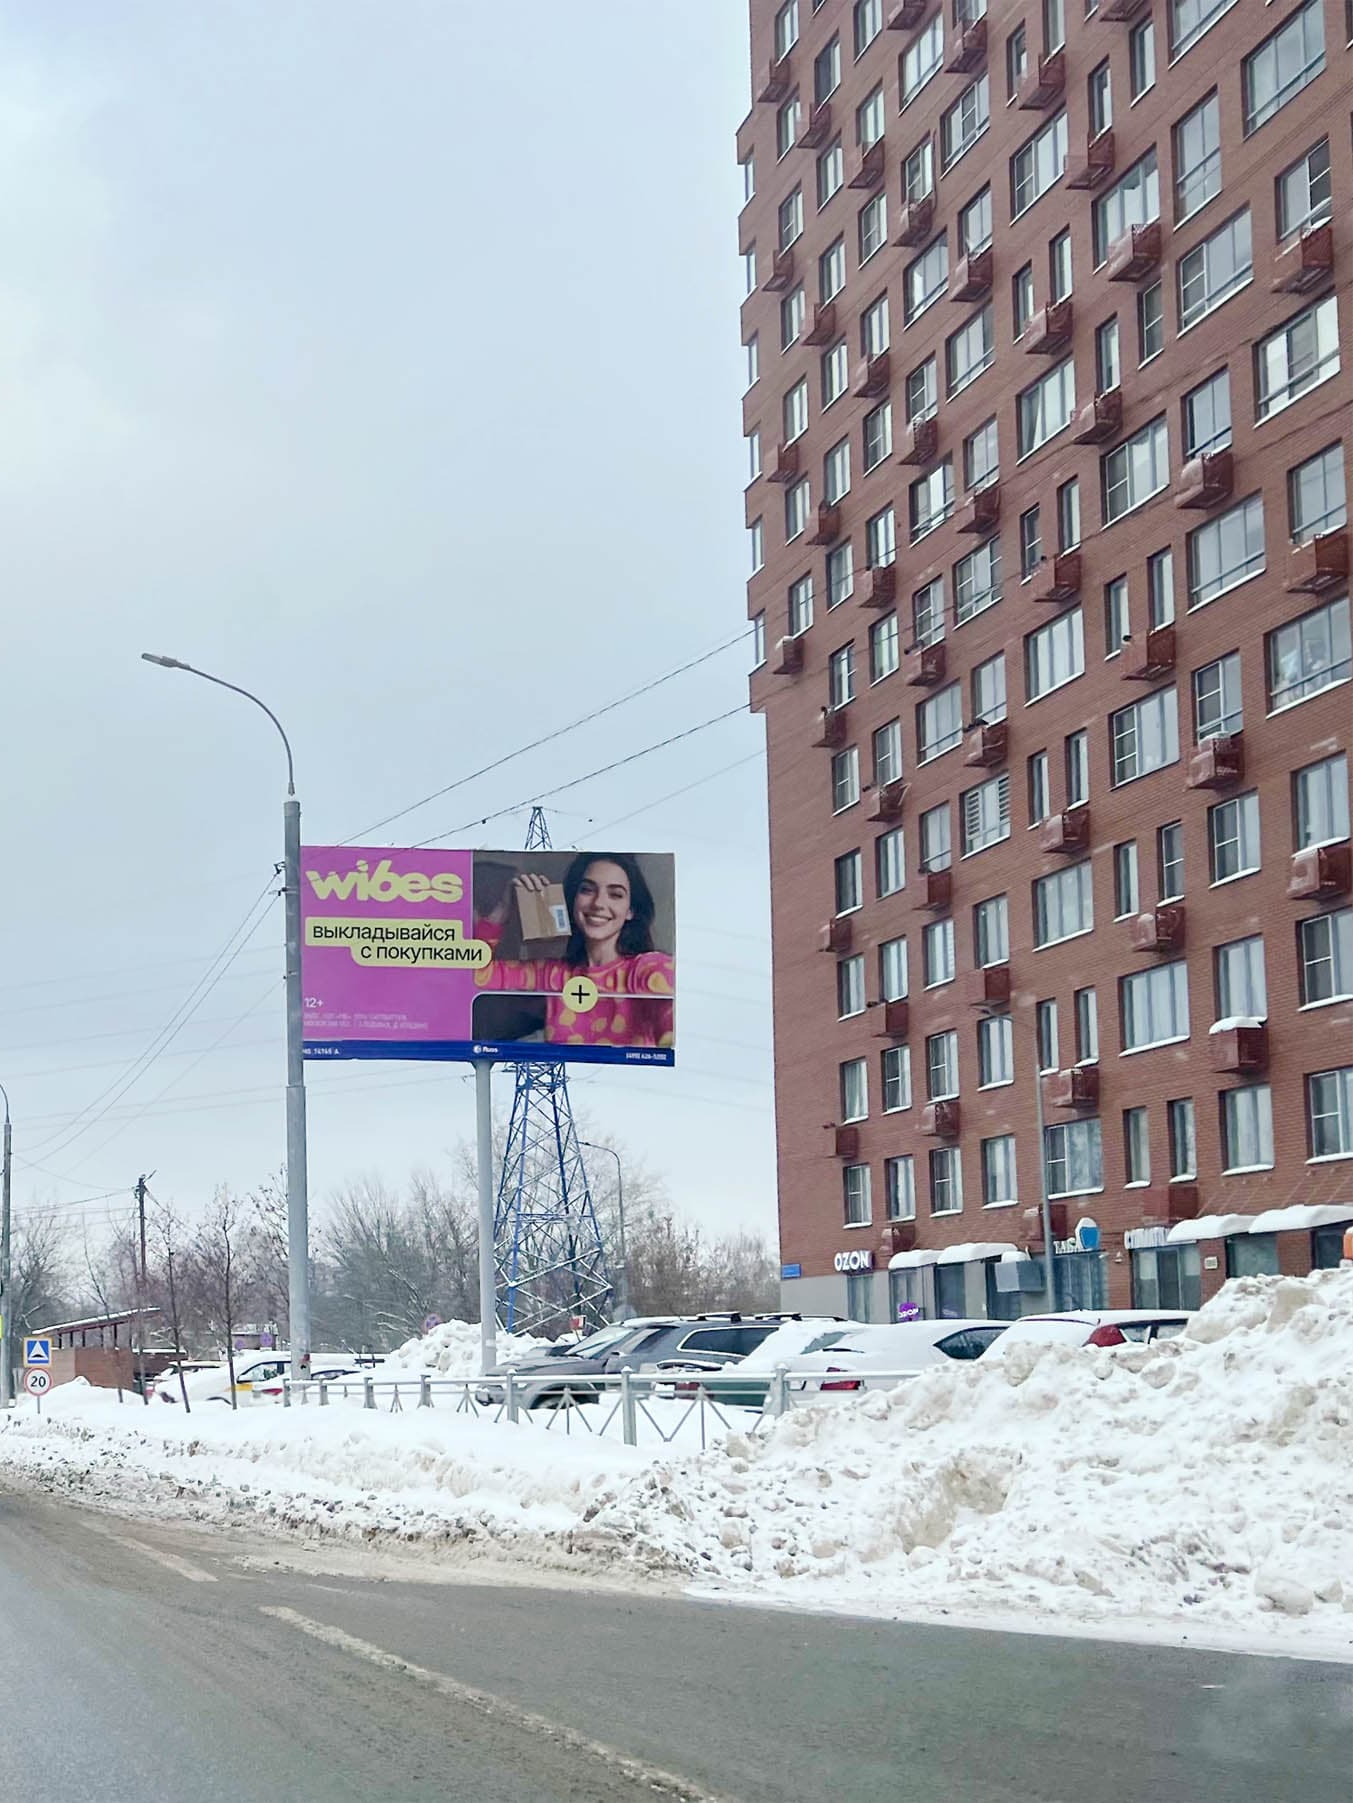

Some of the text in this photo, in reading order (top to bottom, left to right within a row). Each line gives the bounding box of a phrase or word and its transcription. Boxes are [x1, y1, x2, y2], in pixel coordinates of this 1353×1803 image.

[306, 860, 463, 903] wibes
[313, 923, 456, 943] выкладывайся
[361, 945, 482, 964] с покупками
[304, 997, 324, 1008] 12+
[834, 1250, 870, 1271] OZON
[30, 1375, 46, 1388] 20
